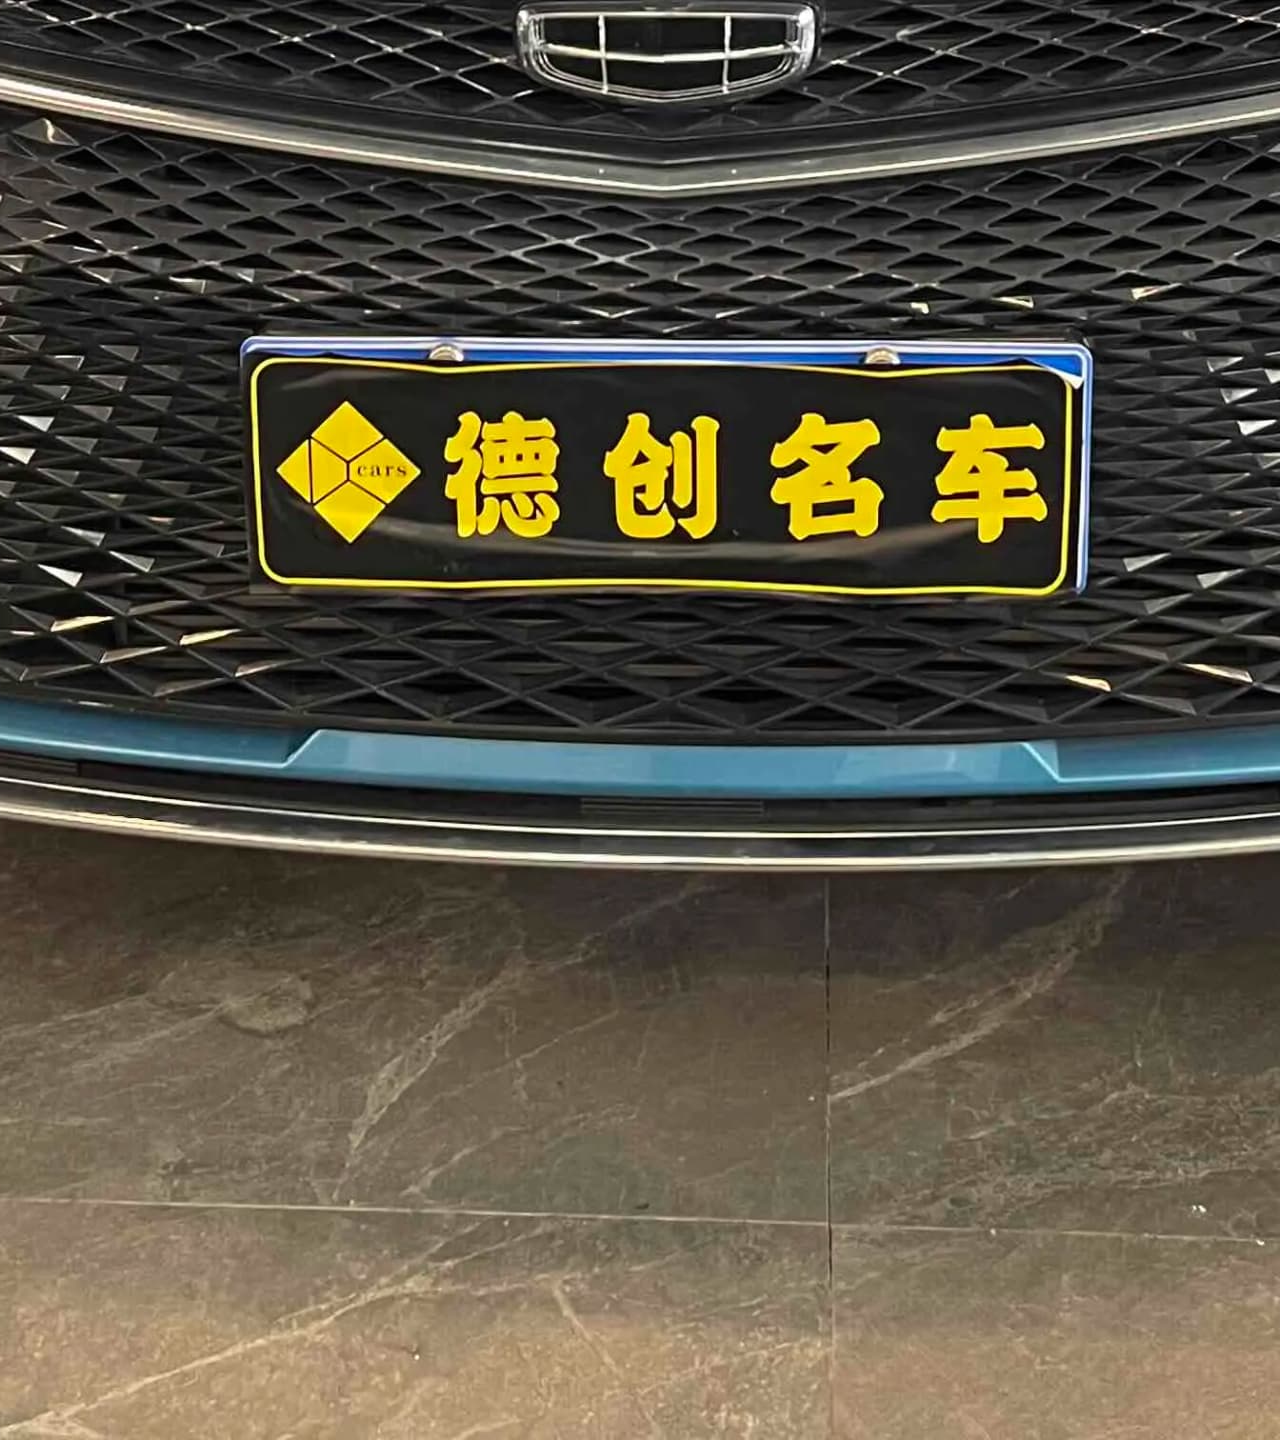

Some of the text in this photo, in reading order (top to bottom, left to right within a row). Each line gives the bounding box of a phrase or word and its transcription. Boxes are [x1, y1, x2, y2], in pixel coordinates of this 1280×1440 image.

[357, 465, 407, 477] cars
[443, 410, 1048, 544] 德创名车
